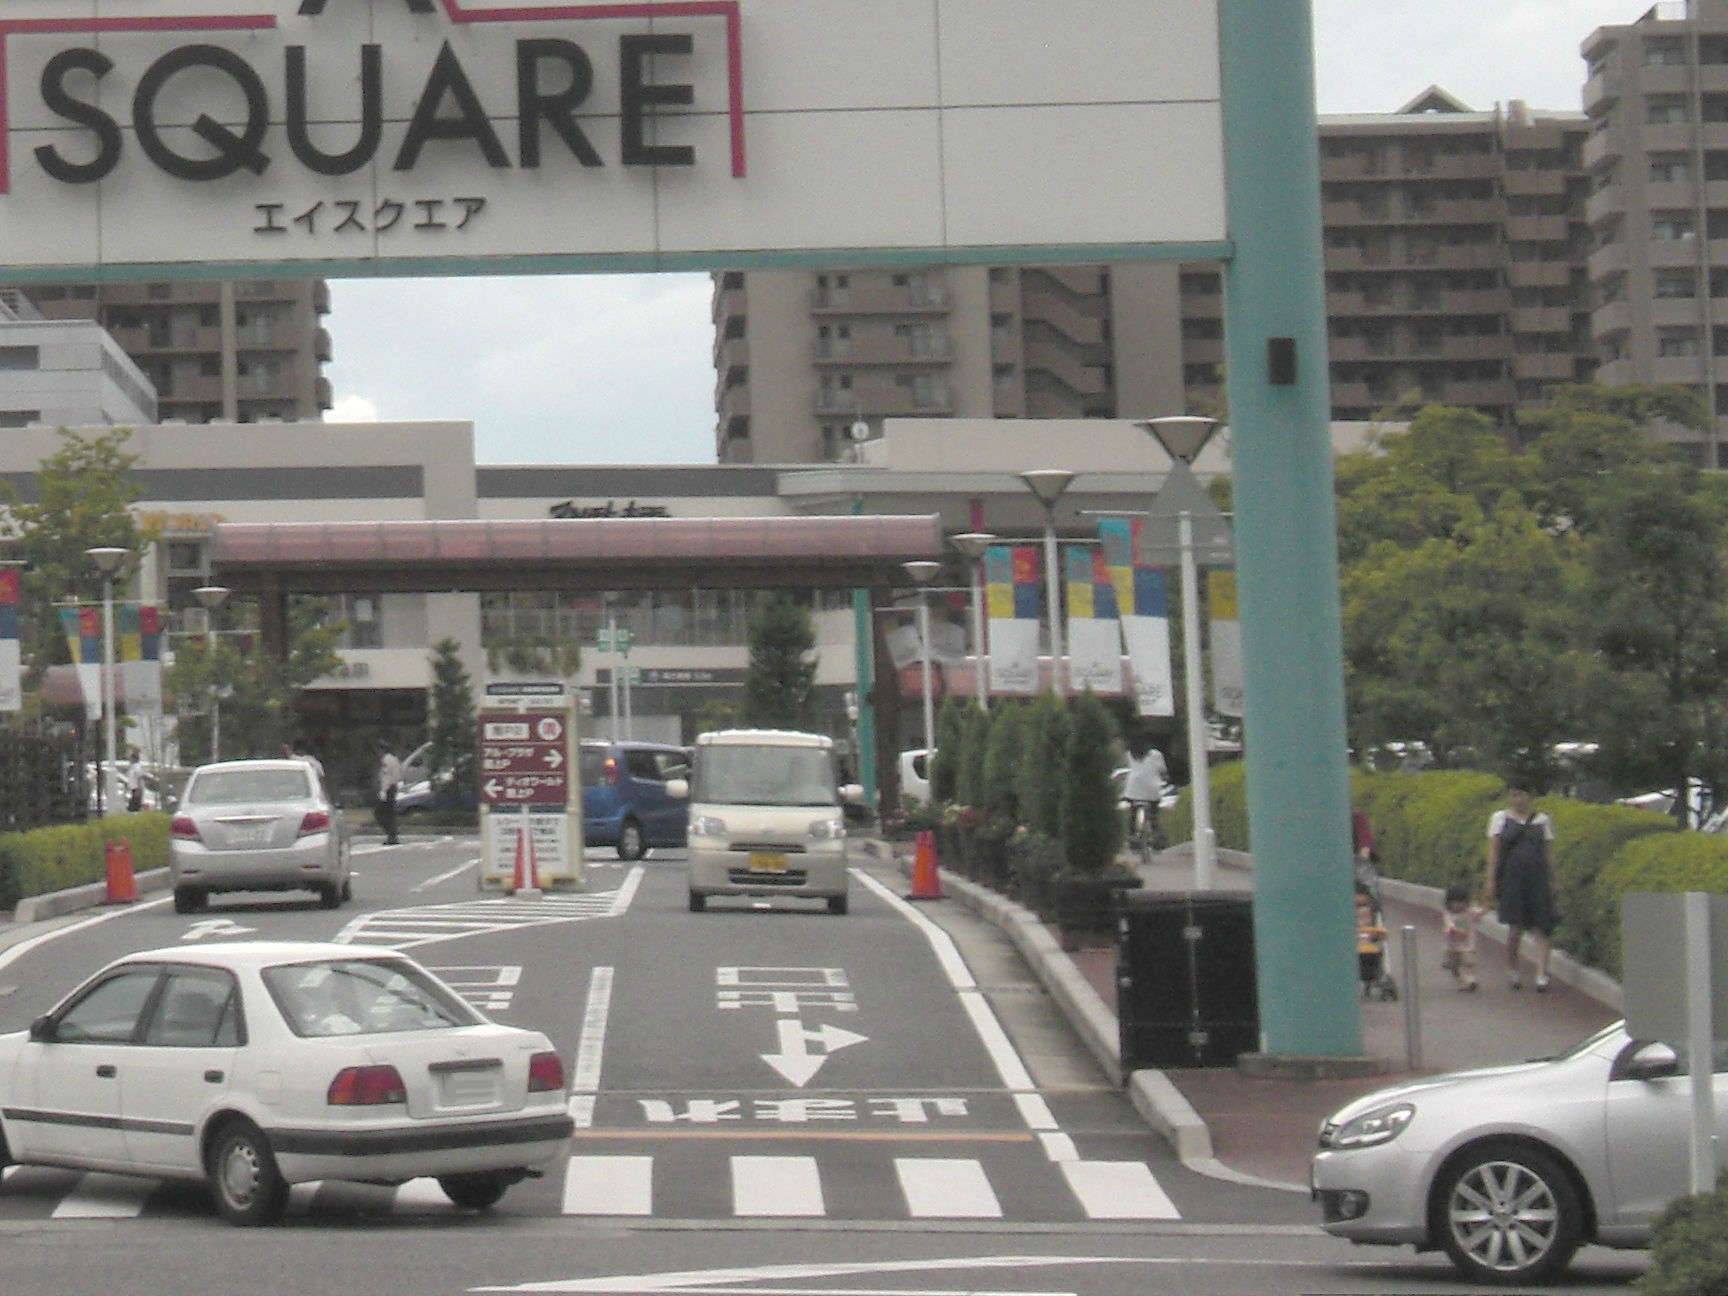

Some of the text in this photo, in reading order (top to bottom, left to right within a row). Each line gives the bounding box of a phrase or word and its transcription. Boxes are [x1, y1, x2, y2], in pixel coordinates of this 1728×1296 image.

[34, 33, 697, 184] SQUARE
[253, 197, 488, 234] エイスクエア
[638, 1097, 969, 1123] 止まれ
